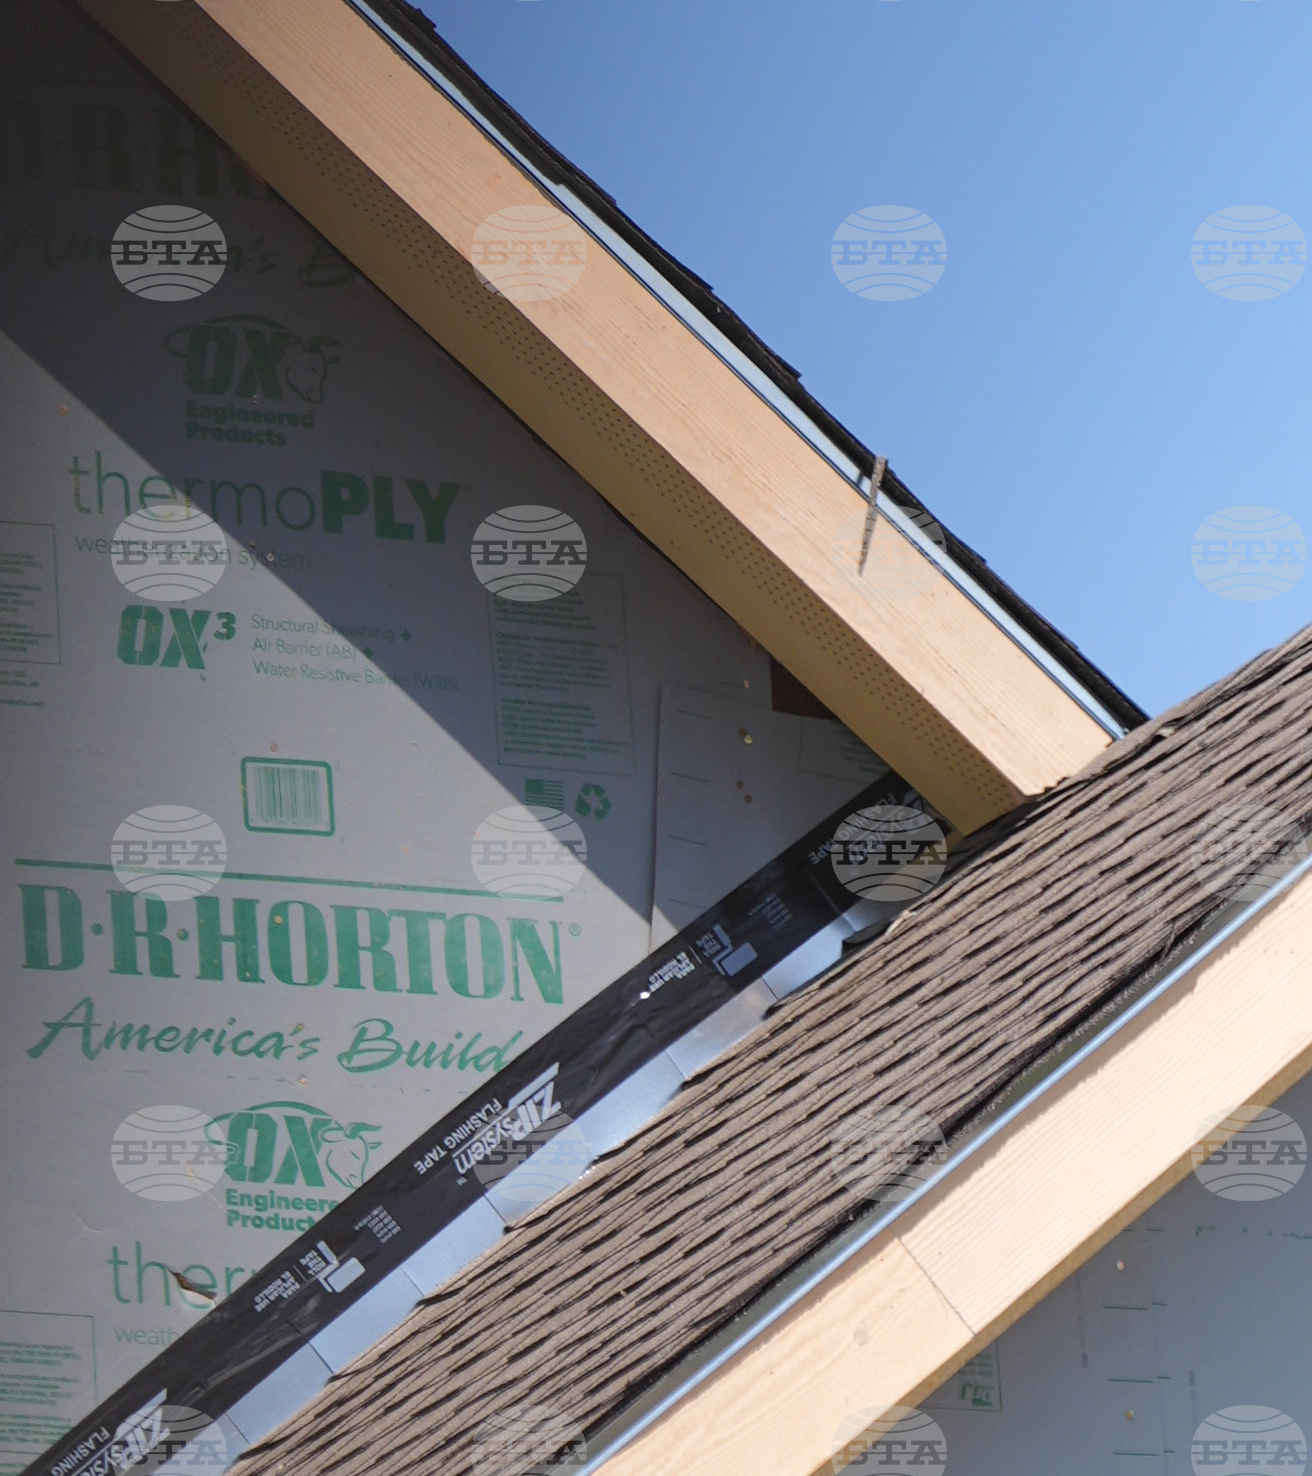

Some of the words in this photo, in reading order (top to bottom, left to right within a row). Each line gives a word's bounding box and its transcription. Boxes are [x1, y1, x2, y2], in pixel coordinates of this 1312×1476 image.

[186, 331, 282, 402] OX
[187, 405, 314, 428] Engineered
[187, 426, 286, 446] Products
[67, 453, 460, 545] thermoPLY
[28, 997, 320, 1062] America's
[337, 1018, 523, 1075] Build
[444, 1098, 502, 1149] FLASHING
[414, 1146, 447, 1175] TAPE
[226, 1188, 339, 1225] Engineere
